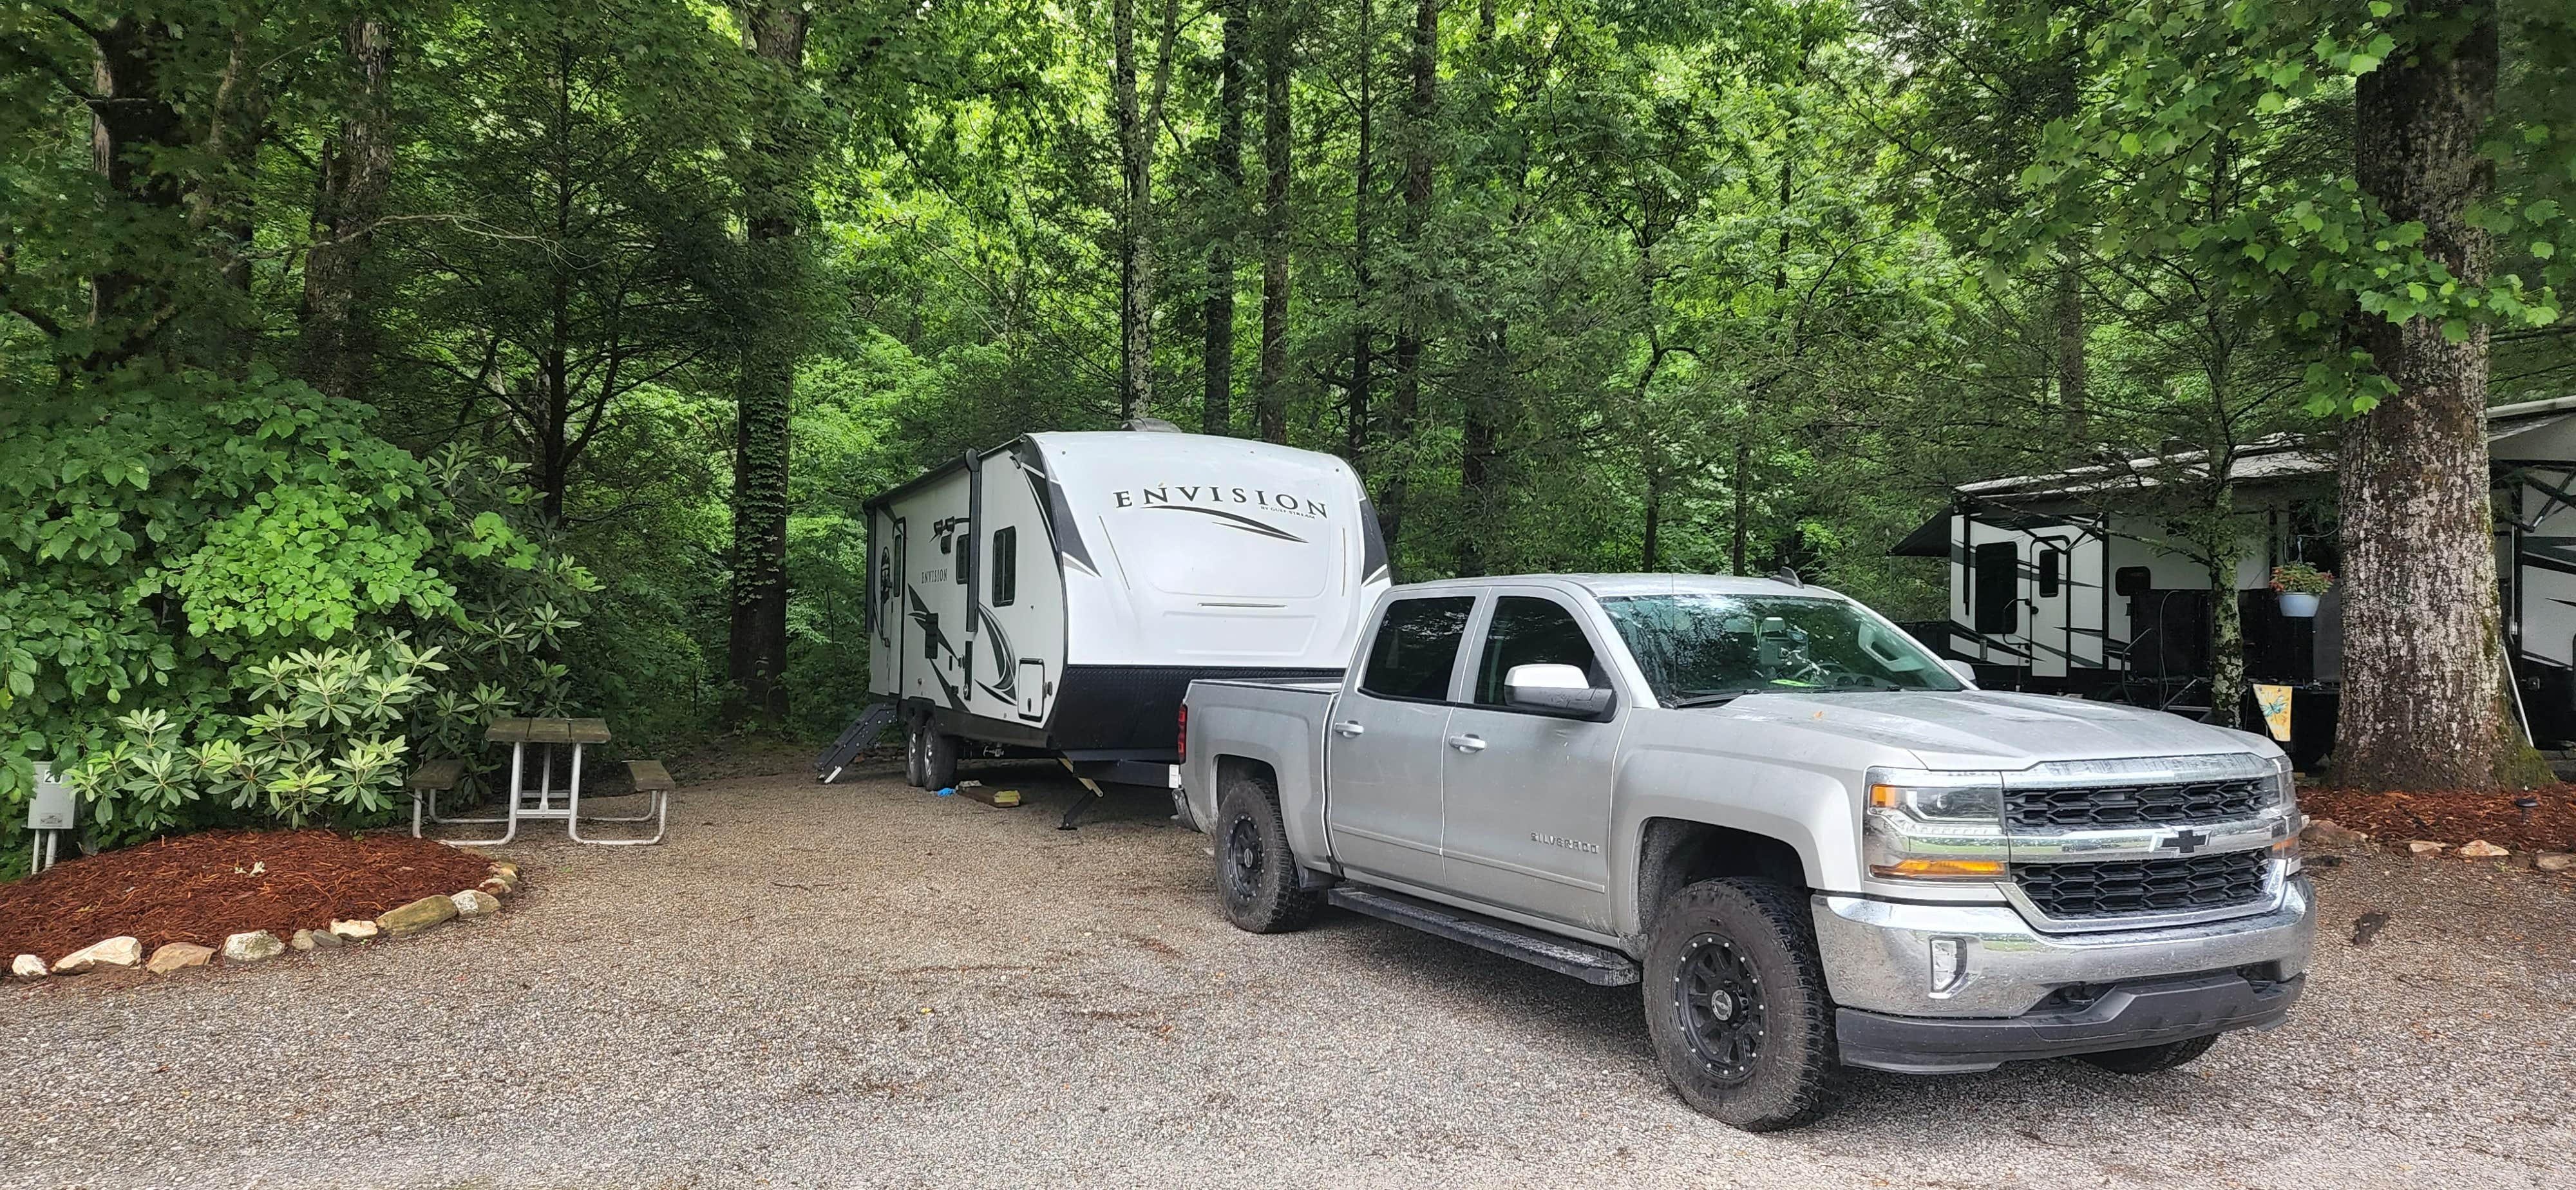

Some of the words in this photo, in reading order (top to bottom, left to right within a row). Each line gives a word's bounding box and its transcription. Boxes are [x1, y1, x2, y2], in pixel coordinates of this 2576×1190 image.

[1113, 487, 1328, 519] ENVISION
[922, 568, 947, 584] ENVISION
[1530, 832, 1599, 854] SILVERADO
